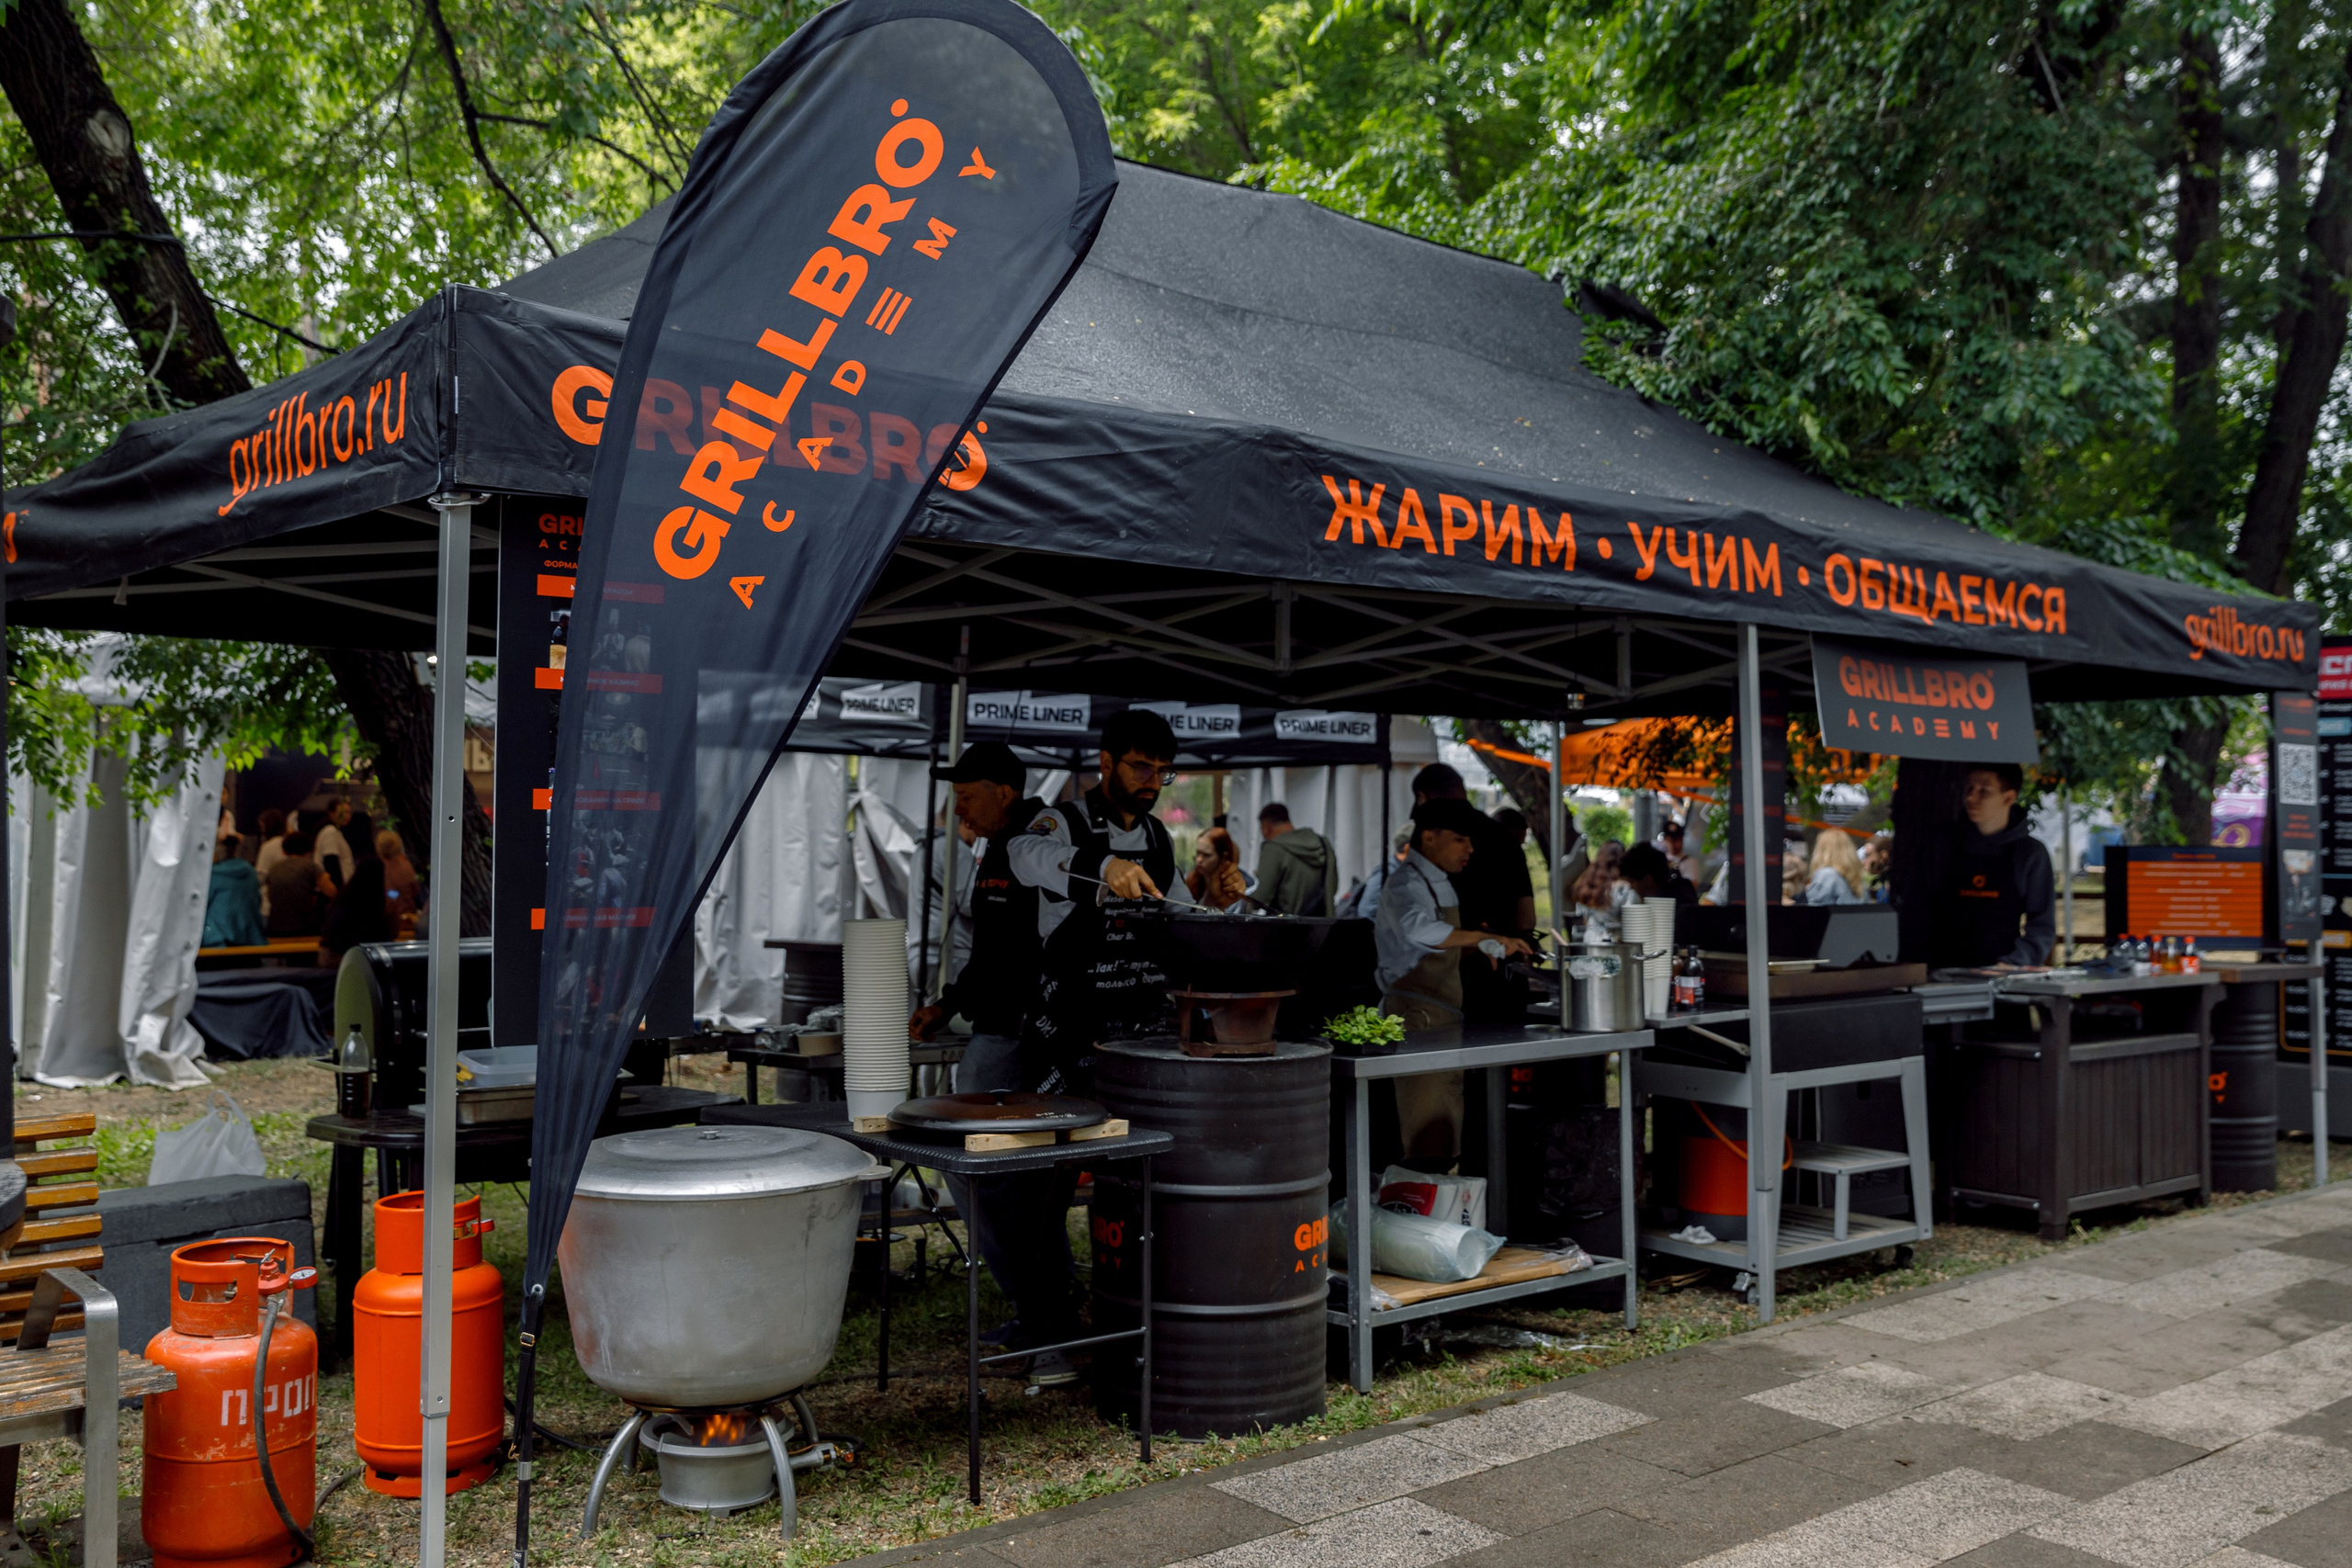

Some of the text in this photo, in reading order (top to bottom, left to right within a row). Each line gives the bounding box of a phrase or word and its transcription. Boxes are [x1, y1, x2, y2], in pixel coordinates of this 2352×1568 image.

[653, 99, 944, 580] GRILLBRO
[729, 146, 997, 610] ACADEMY
[218, 371, 408, 517] grillbro.ru
[1321, 474, 2067, 635] ЖАРИМ УЧИМ ОБЩАЕМСЯ
[2184, 604, 2305, 662] grillbro.ru
[1839, 655, 1996, 711] GRILLBRO
[974, 703, 1083, 725] PRIME LINER
[1188, 715, 1234, 732] LINER
[1279, 718, 1372, 736] PRIME LINER
[1847, 707, 2000, 740] ACADEMY
